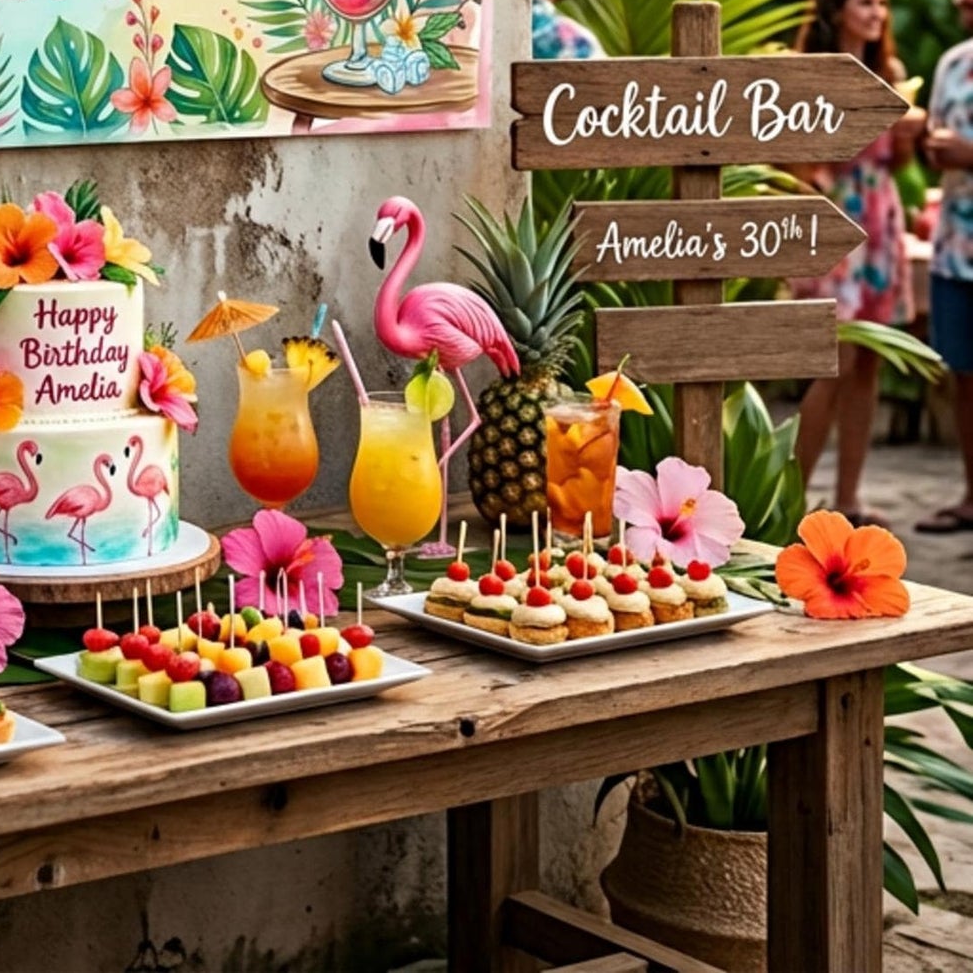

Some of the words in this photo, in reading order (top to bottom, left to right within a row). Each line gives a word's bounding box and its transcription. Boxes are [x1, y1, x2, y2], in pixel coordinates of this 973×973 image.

[543, 79, 733, 146] Cocktail
[743, 78, 844, 142] Bar
[596, 220, 726, 264] Amelia's
[33, 298, 118, 335] Happy
[19, 336, 129, 374] Birthday
[35, 372, 122, 405] Amelia
